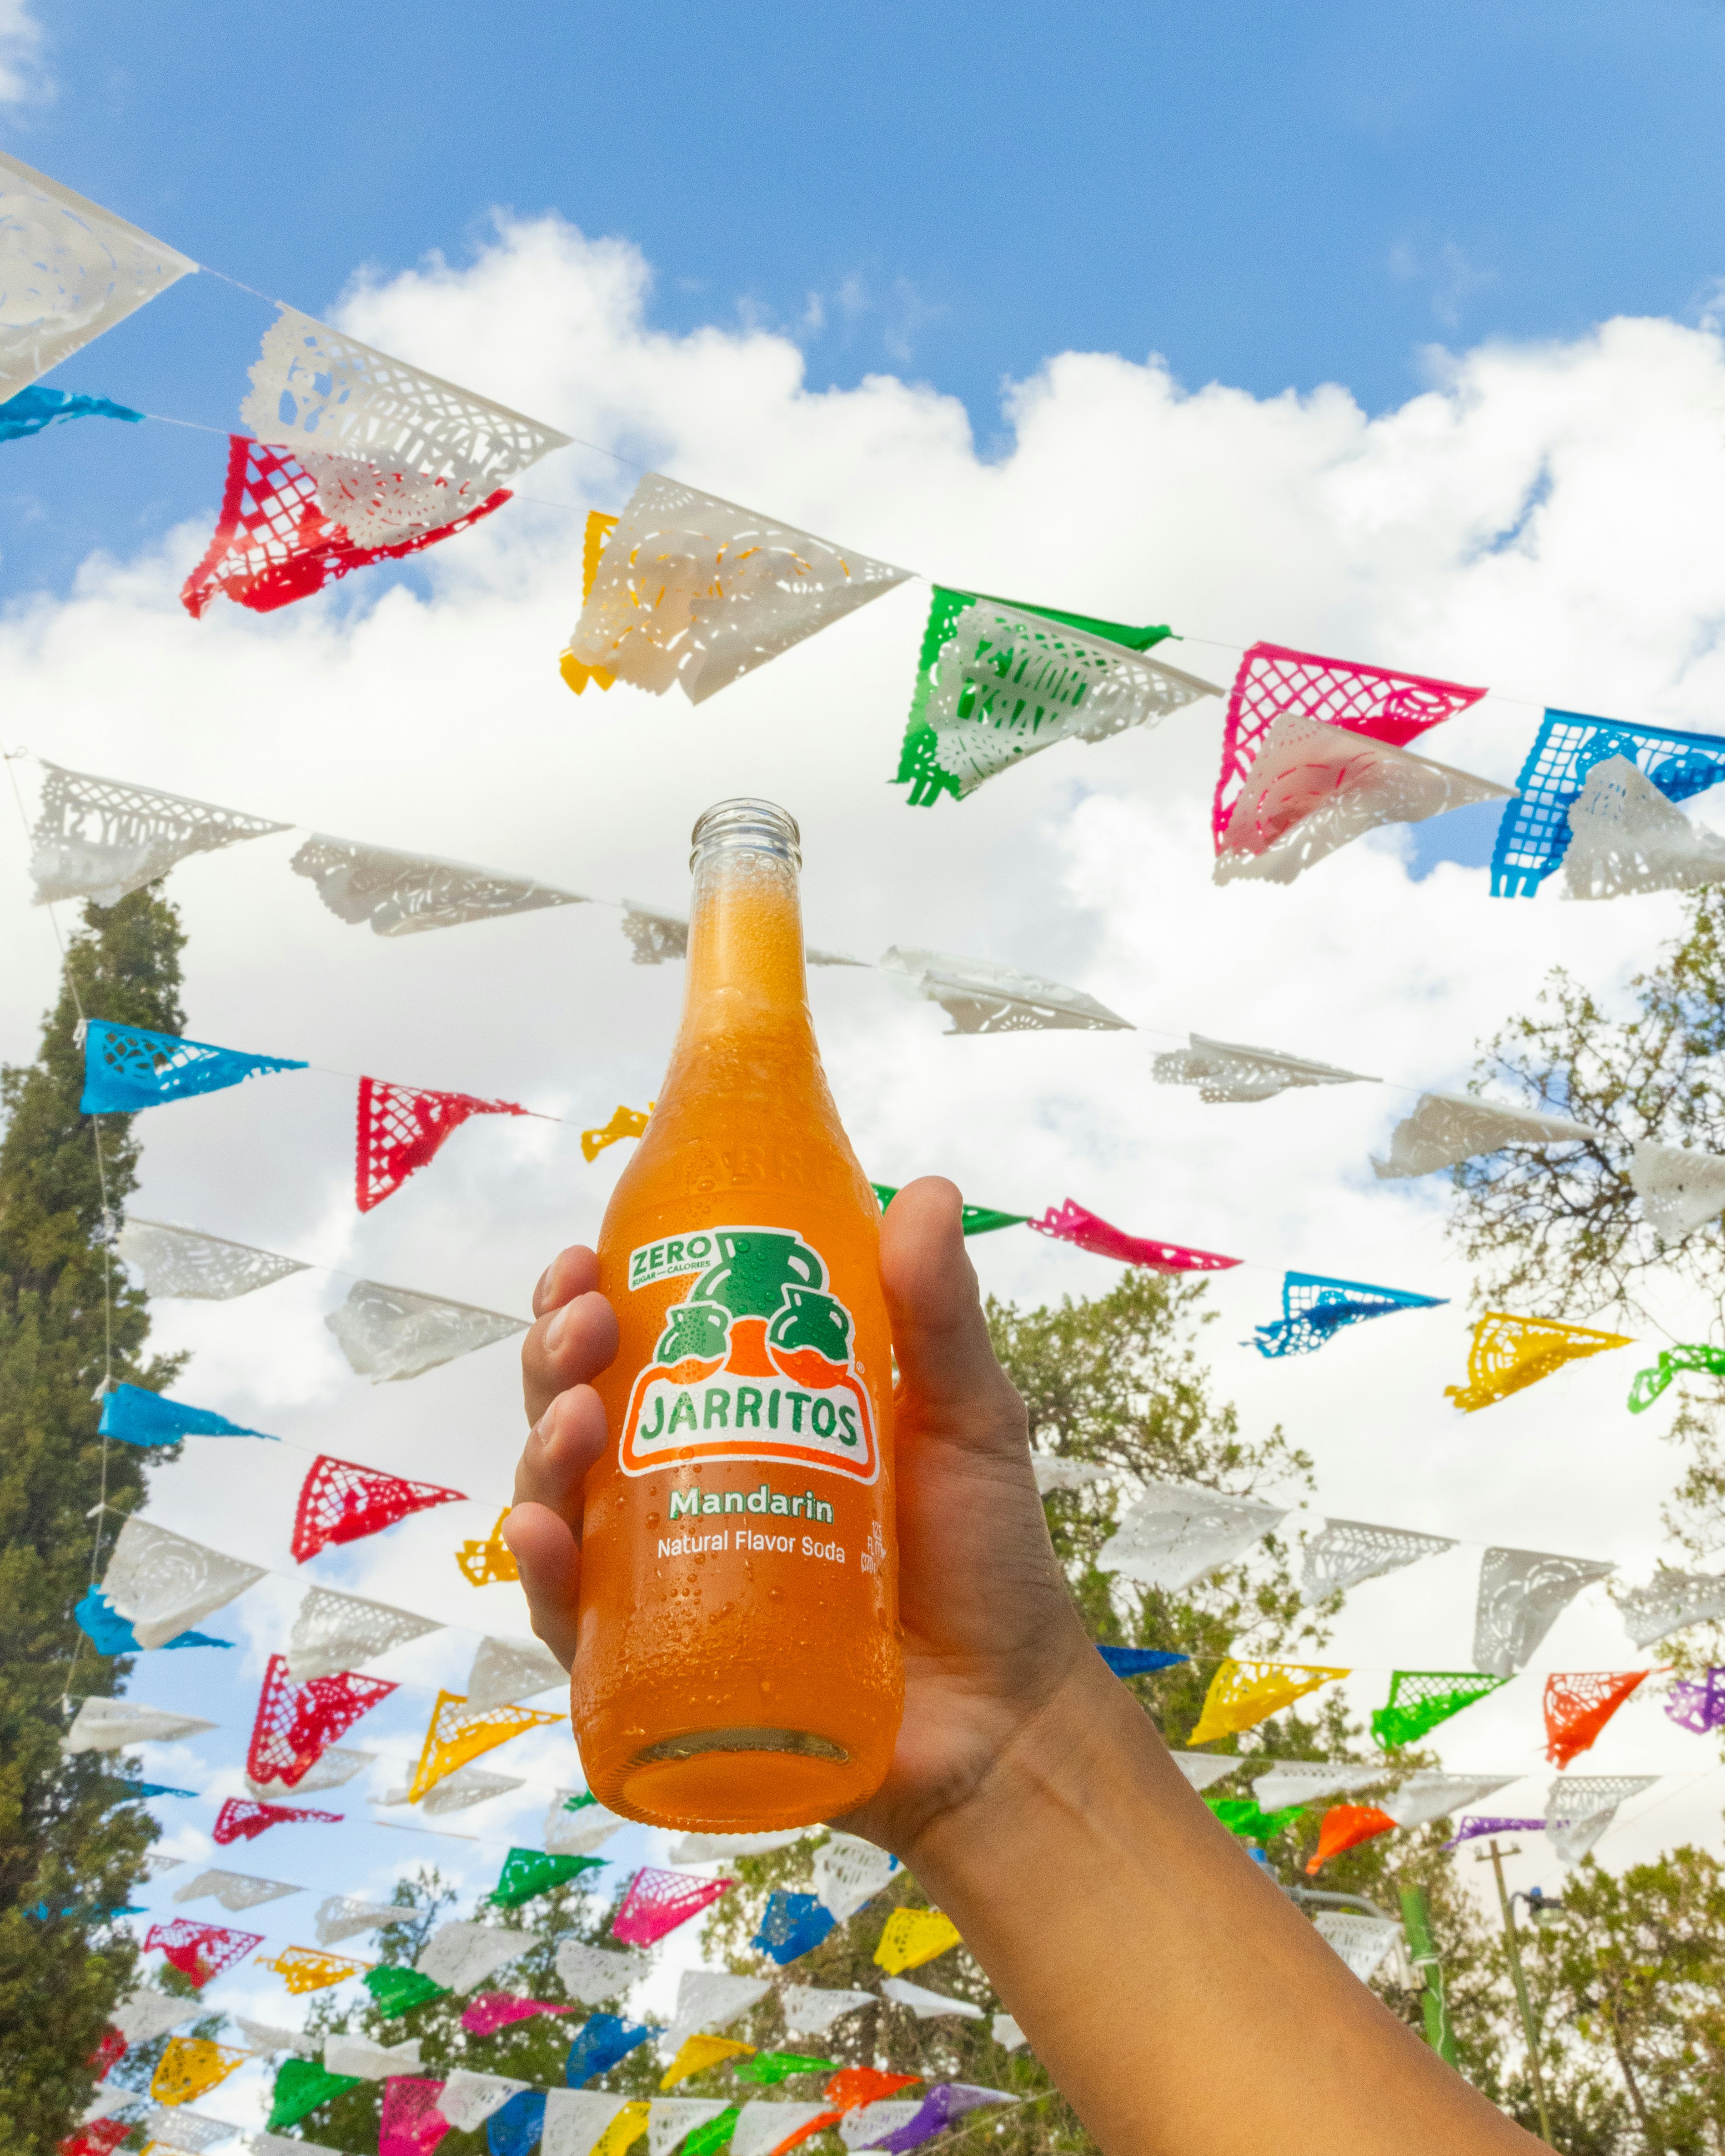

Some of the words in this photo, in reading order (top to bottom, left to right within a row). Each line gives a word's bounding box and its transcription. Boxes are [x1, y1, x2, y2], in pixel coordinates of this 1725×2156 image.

[632, 1272, 656, 1287] SUGAR
[667, 1261, 711, 1274] CALORIES
[633, 1236, 712, 1277] ZERO
[640, 1386, 858, 1446] JARRITOS
[669, 1484, 834, 1525] Mandarin
[658, 1530, 728, 1558] Natural
[736, 1530, 796, 1552] Flavor
[802, 1536, 845, 1563] Soda
